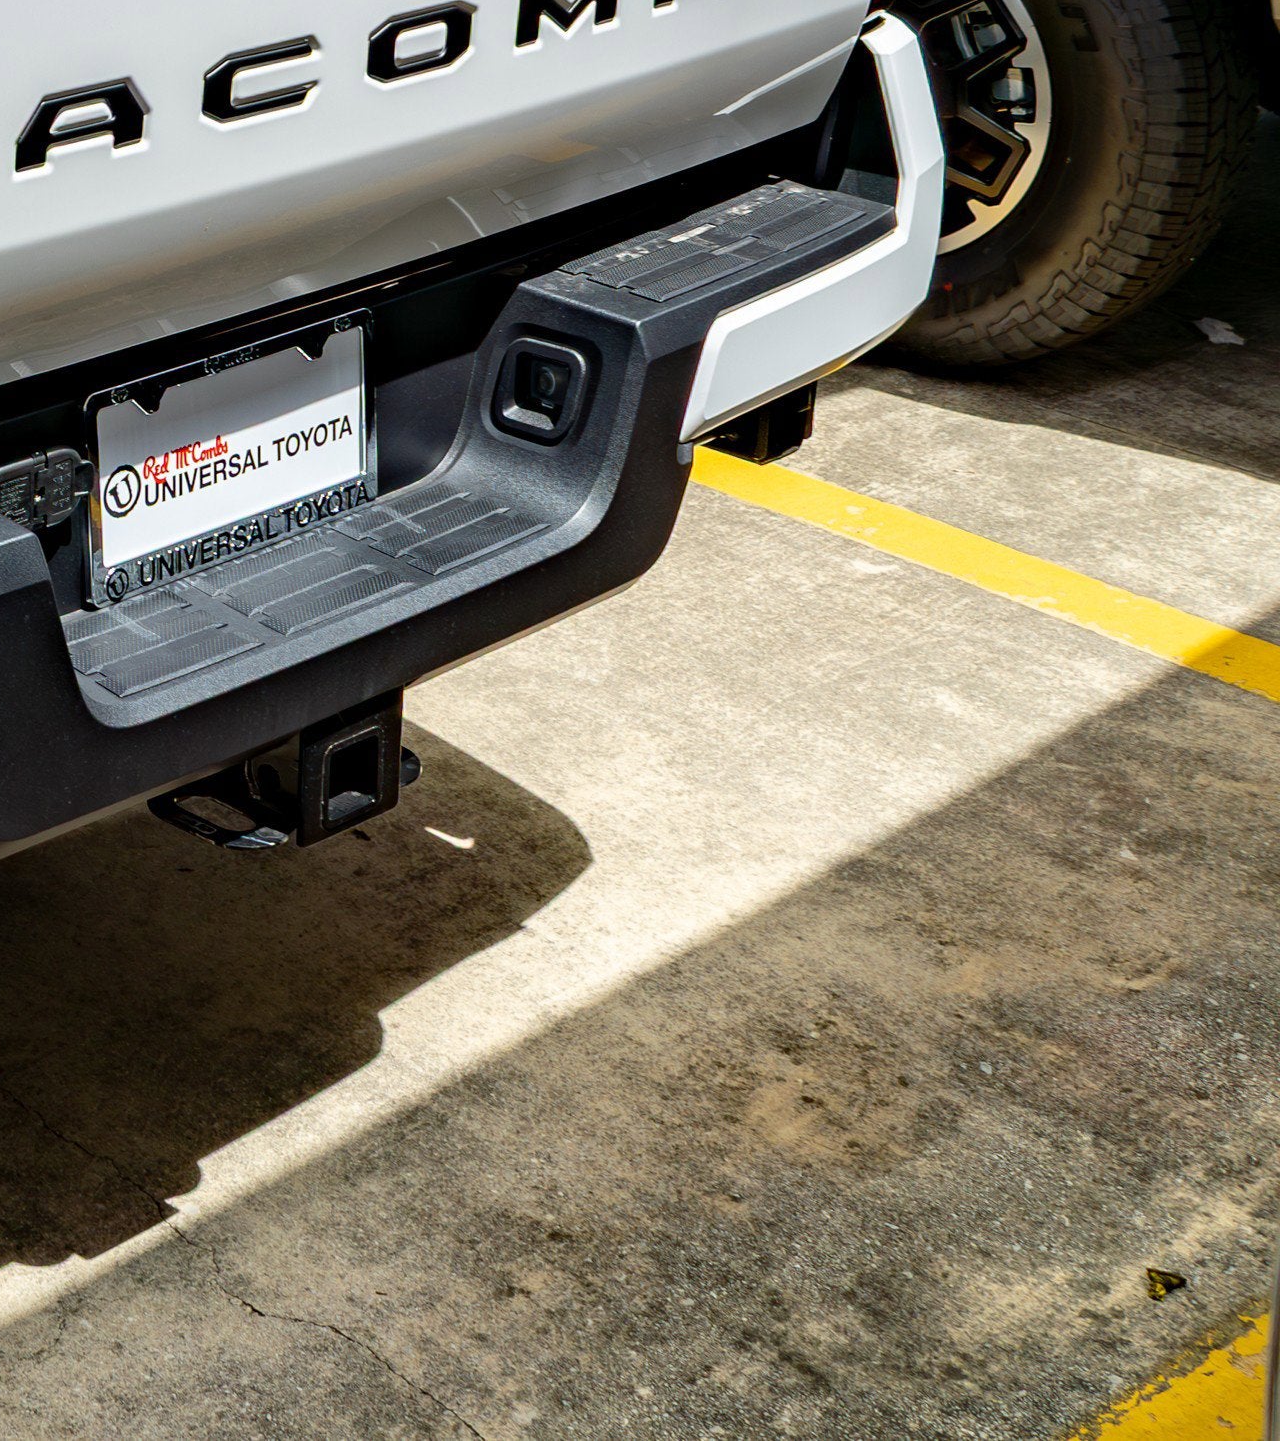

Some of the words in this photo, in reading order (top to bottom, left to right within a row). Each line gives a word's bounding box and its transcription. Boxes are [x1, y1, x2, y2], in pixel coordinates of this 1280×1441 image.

[142, 451, 170, 485] Red
[144, 445, 269, 507] UNIVERSAL
[272, 415, 353, 462] TOYOTA
[138, 514, 280, 588] UNIVERSAL
[280, 481, 372, 533] TOYOTA
